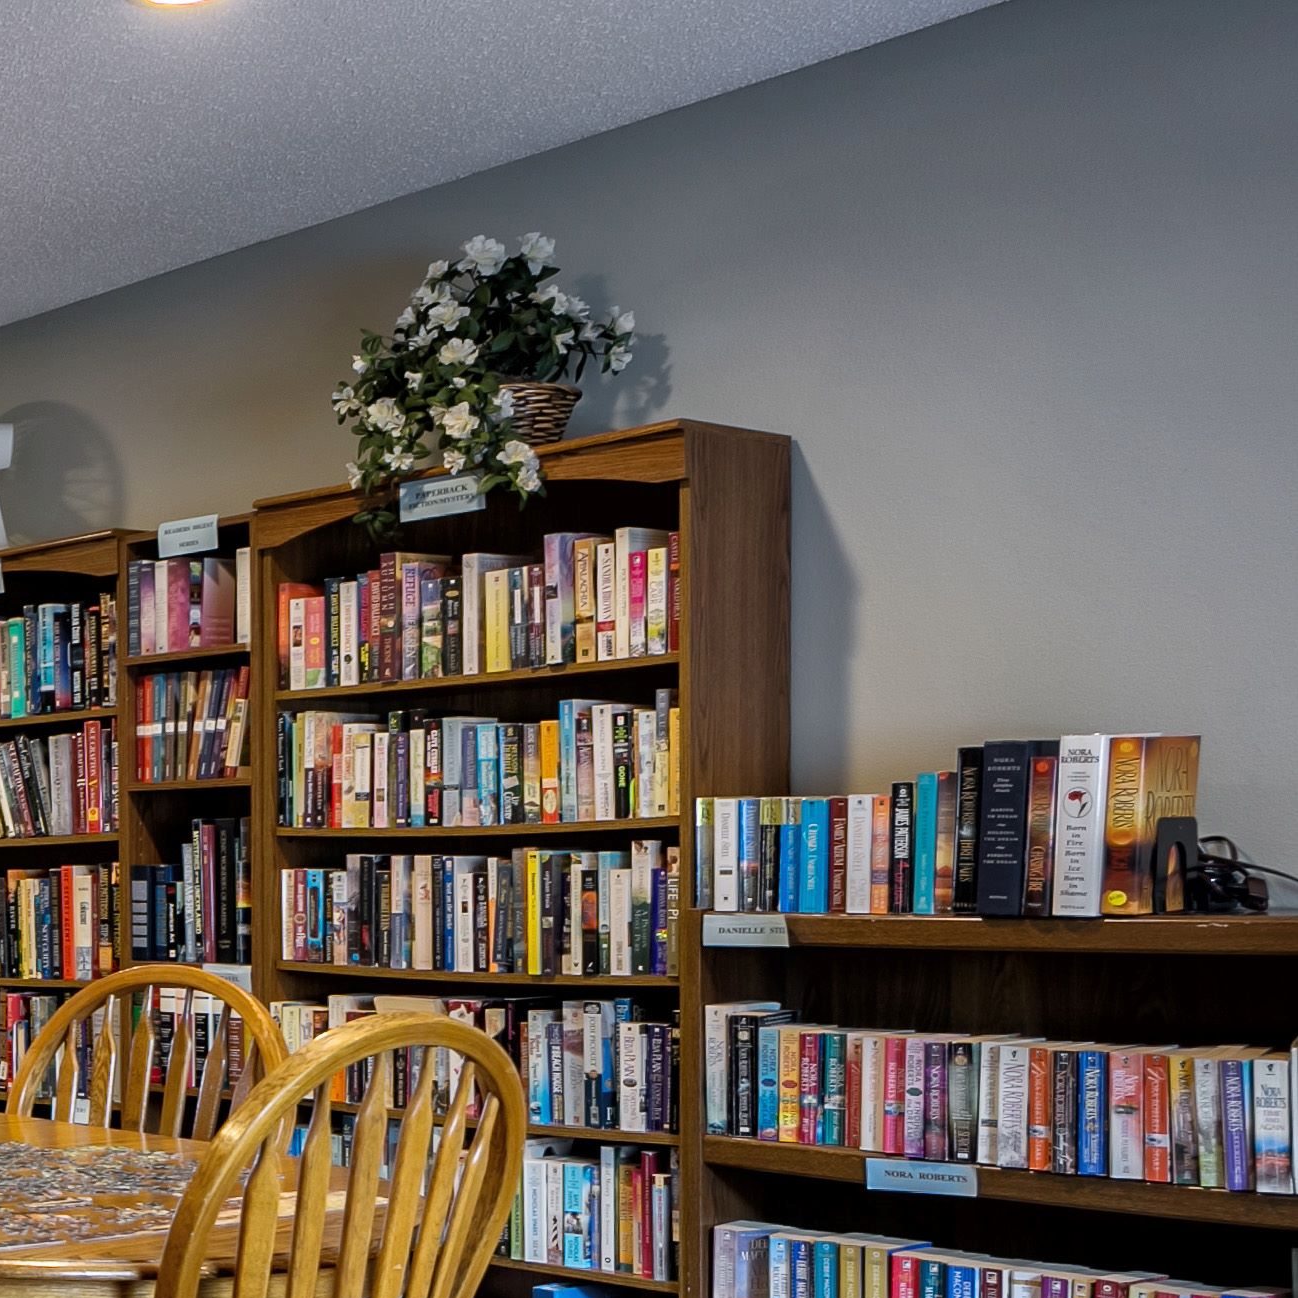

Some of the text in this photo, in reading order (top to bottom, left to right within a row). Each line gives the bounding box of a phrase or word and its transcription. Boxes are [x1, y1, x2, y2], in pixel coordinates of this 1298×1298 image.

[416, 484, 468, 501] PAPERBACK
[405, 568, 415, 607] REFUGE
[578, 552, 588, 608] APPALACHIA
[602, 558, 612, 620] SANDRA BROWN
[371, 582, 380, 636] DAVID BALDACCI
[88, 779, 98, 788] V
[1156, 744, 1190, 792] NORA
[504, 792, 512, 819] COUNTRY
[1110, 757, 1140, 829] NORA ROBERTS
[894, 808, 909, 858] JAMES PATTERSON
[192, 830, 202, 934] MYSTERIES UNEXPLAINED
[668, 878, 679, 920] LIFE PI
[718, 926, 756, 936] DANIELLE
[589, 1016, 597, 1034] JODI
[552, 1051, 562, 1093] BEACH HOUSE
[623, 1054, 635, 1077] PLAIN
[801, 1058, 809, 1092] ROBERTS
[829, 1058, 837, 1093] ROBERTS
[888, 1062, 896, 1098] ROBERTS
[930, 1065, 940, 1119] NORA ROBERTS
[1002, 1063, 1025, 1129] NORA ROBERTS
[1085, 1069, 1100, 1120] NORA ROBERTS
[1226, 1076, 1242, 1132] NORA ROBERTS
[1255, 1098, 1286, 1108] ROBERTS
[1259, 1084, 1282, 1097] NORA
[884, 1169, 969, 1184] NORA ROBERTS
